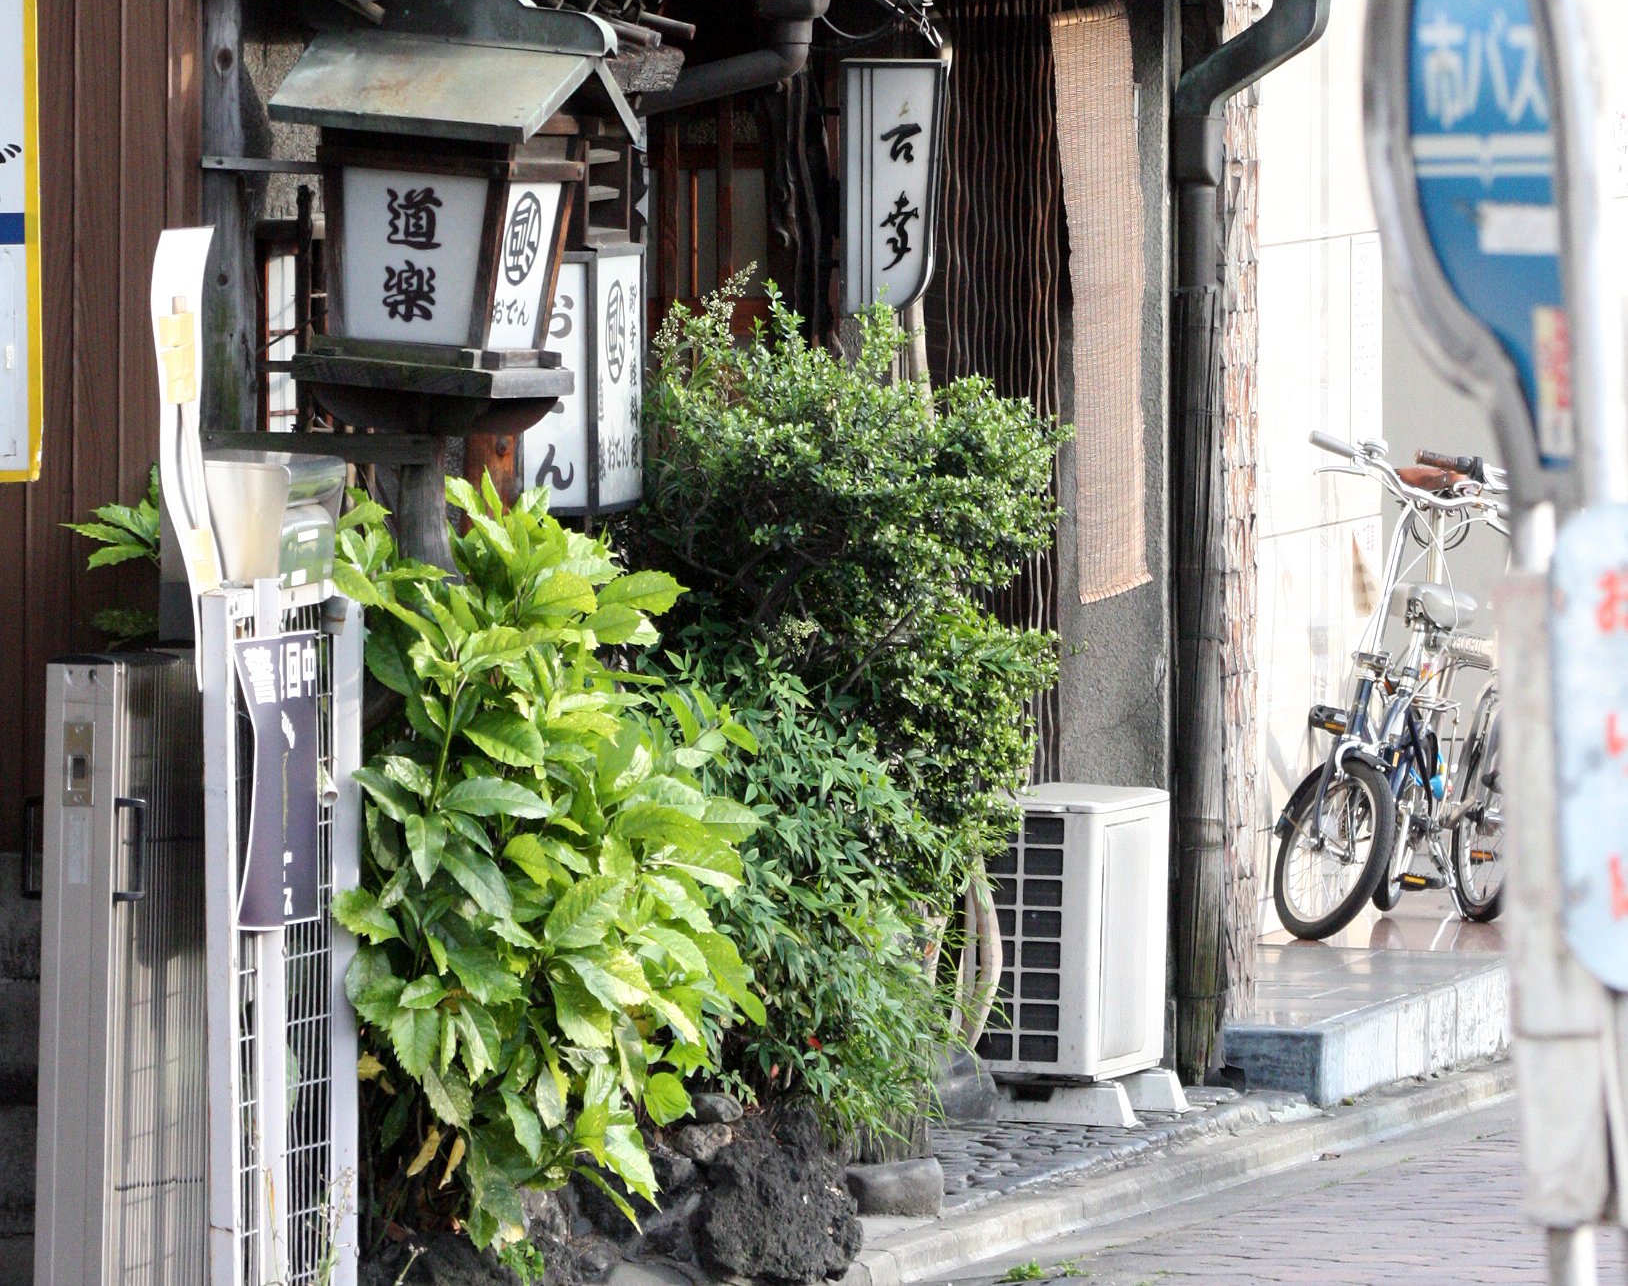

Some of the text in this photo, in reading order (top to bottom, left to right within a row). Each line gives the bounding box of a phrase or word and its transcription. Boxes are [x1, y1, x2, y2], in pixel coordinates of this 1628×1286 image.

[382, 187, 442, 323] 道楽
[491, 298, 530, 327] おでん
[607, 434, 629, 469] おでん
